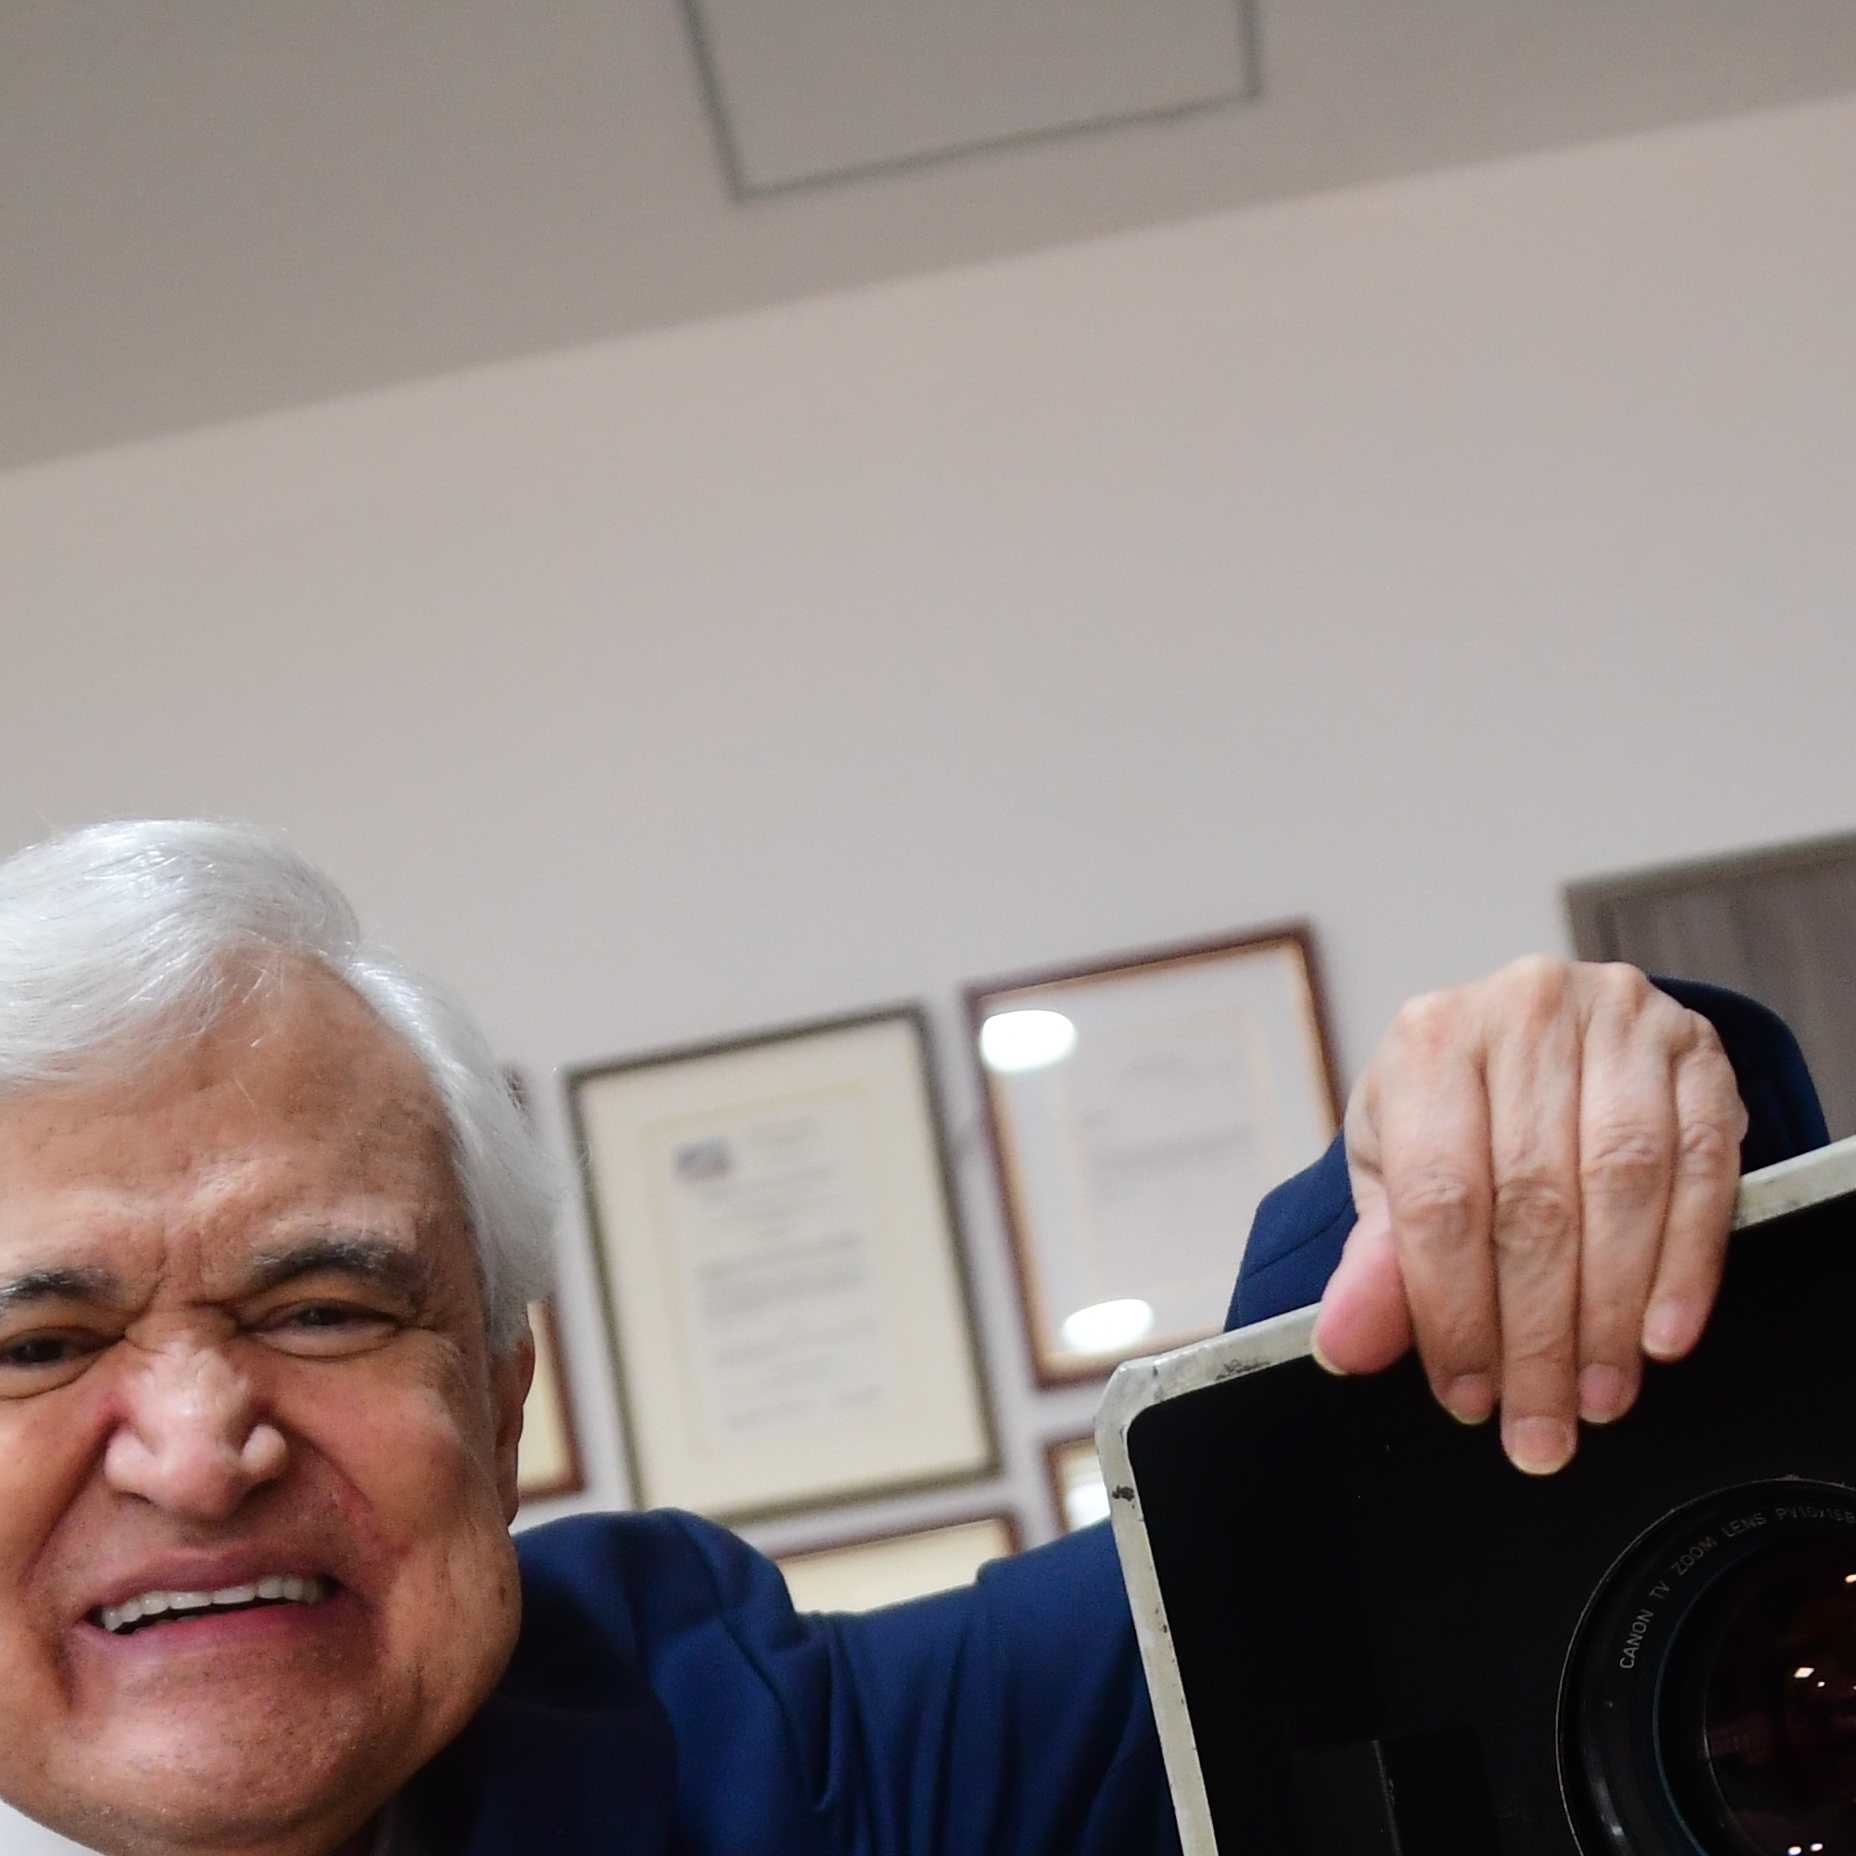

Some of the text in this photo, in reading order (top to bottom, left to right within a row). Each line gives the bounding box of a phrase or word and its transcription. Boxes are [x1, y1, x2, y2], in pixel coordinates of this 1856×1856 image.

[1619, 1608, 1654, 1669] CANON
[1648, 1580, 1670, 1599] TV
[1670, 1536, 1718, 1576] ZOOM
[1721, 1512, 1767, 1538] LENS
